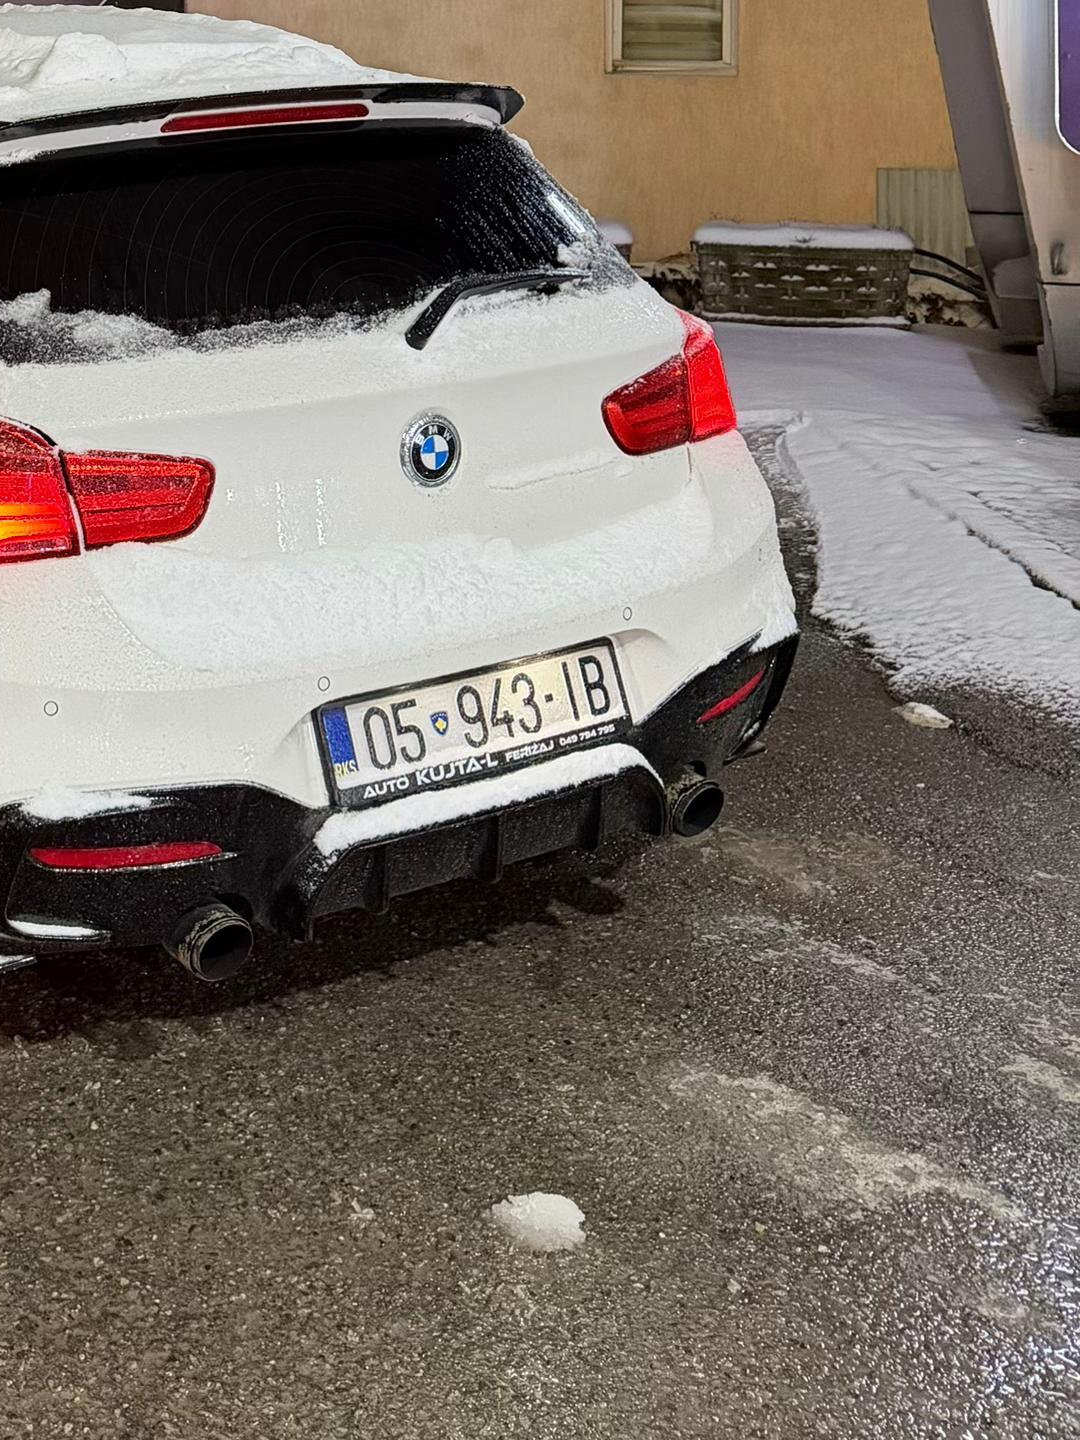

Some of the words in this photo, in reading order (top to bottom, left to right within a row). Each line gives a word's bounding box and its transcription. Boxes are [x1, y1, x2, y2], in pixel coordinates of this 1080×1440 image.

[415, 425, 453, 445] BMW
[362, 698, 426, 770] 05
[334, 759, 358, 777] RKS
[363, 777, 409, 799] AUTO
